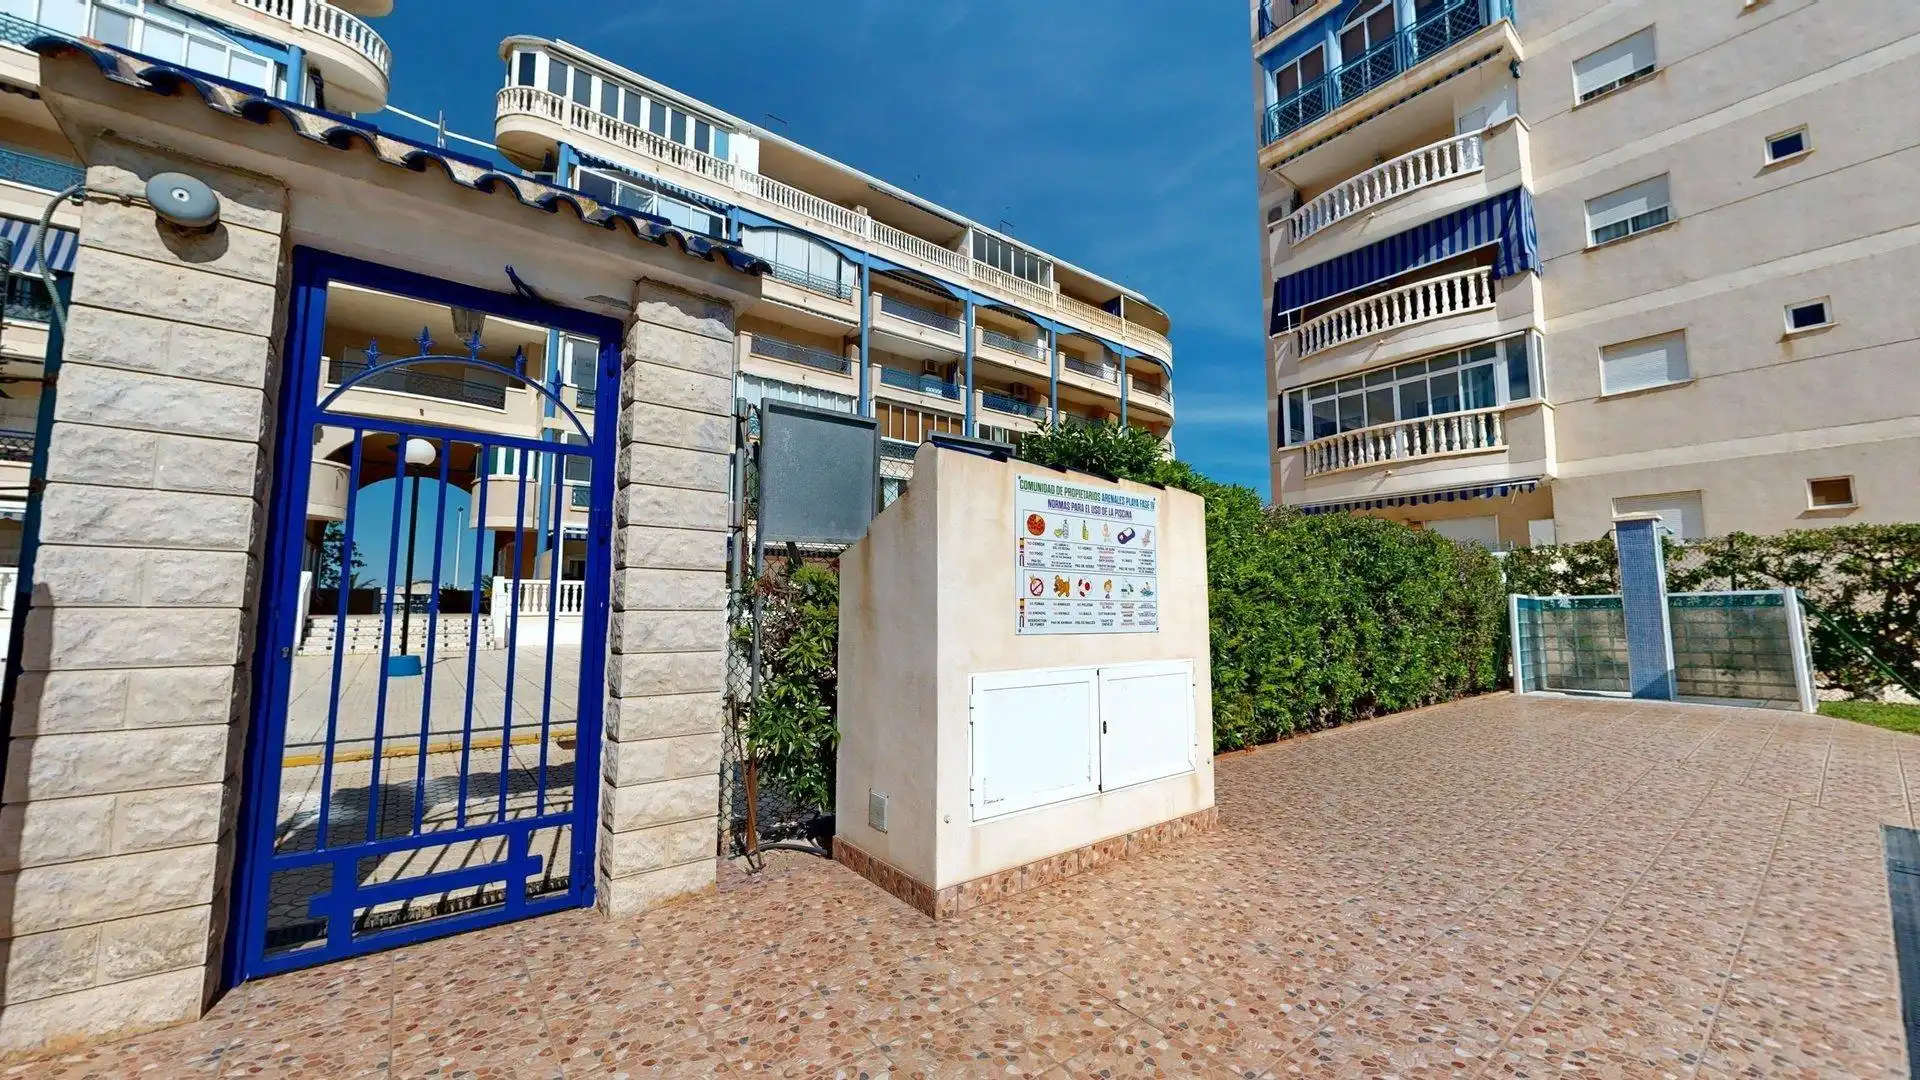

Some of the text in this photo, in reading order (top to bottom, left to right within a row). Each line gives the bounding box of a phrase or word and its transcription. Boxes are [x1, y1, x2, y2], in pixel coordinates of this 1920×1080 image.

[1019, 479, 1055, 494] COMUNIDAD
[1056, 486, 1063, 496] DE
[1064, 487, 1101, 502] PROPIETARIOS
[1101, 493, 1125, 506] ARENALES
[1125, 497, 1139, 507] PLAYA
[1139, 499, 1150, 510] FASE
[1048, 498, 1132, 519] NORMAS PARA EL USO DE LA PISCINA
